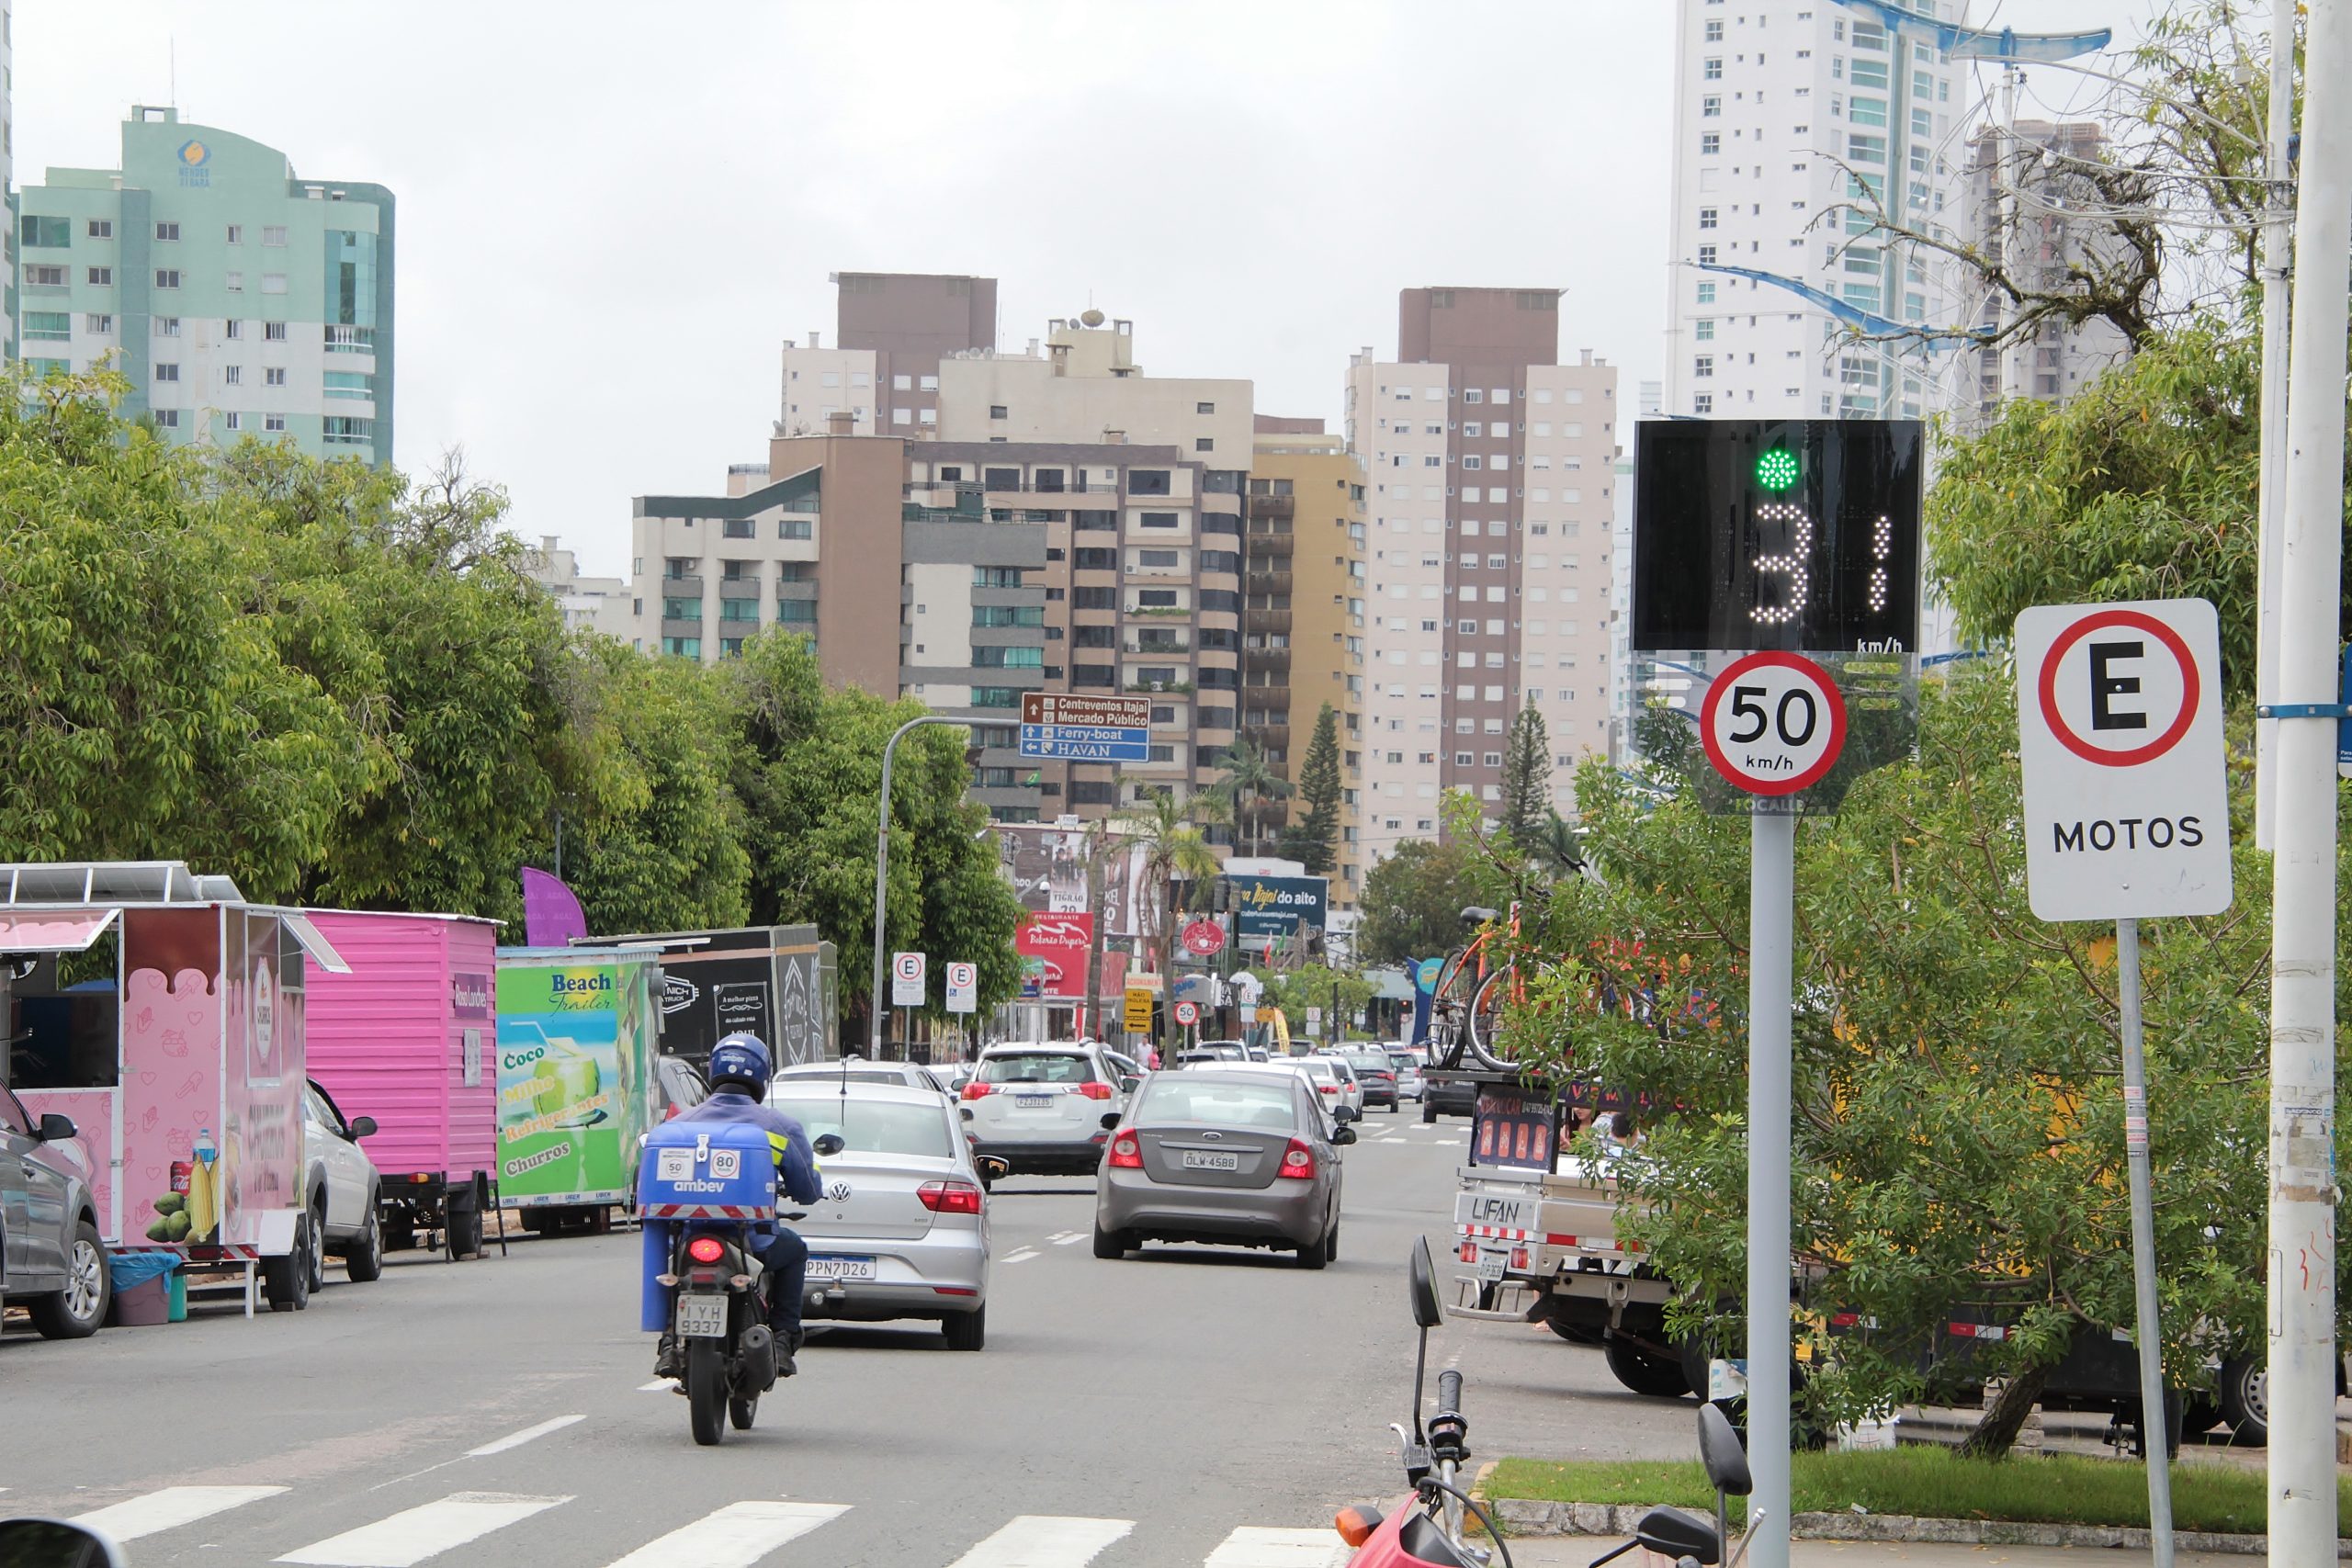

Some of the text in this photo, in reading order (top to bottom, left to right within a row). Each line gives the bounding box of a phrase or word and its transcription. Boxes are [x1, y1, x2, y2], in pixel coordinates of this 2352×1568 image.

[1749, 504, 1893, 624] 31
[1857, 637, 1903, 655] km/h
[2088, 641, 2147, 731] E
[1058, 698, 1148, 716] Centreventos Itajaí
[1057, 711, 1148, 726] Mercado Público
[1729, 686, 1816, 747] 50
[1057, 727, 1123, 743] Ferry-boat
[1057, 743, 1110, 757] HAVAN
[1747, 754, 1793, 771] km/h
[2053, 816, 2203, 852] MOTOS
[1277, 890, 1293, 904] do
[1294, 891, 1317, 905] alto
[904, 960, 914, 975] E
[957, 969, 967, 982] E
[551, 974, 611, 992] Beach
[548, 992, 612, 1017] Trailer
[1180, 1007, 1194, 1017] 50
[503, 1046, 545, 1070] Coco
[503, 1076, 555, 1104] Milho
[506, 1143, 571, 1177] Churros
[669, 1163, 682, 1171] 50
[717, 1156, 734, 1168] 80
[673, 1179, 726, 1192] ambev
[1472, 1198, 1520, 1224] LIFAN
[807, 1260, 867, 1276] PPN7D26
[681, 1320, 720, 1334] 9337
